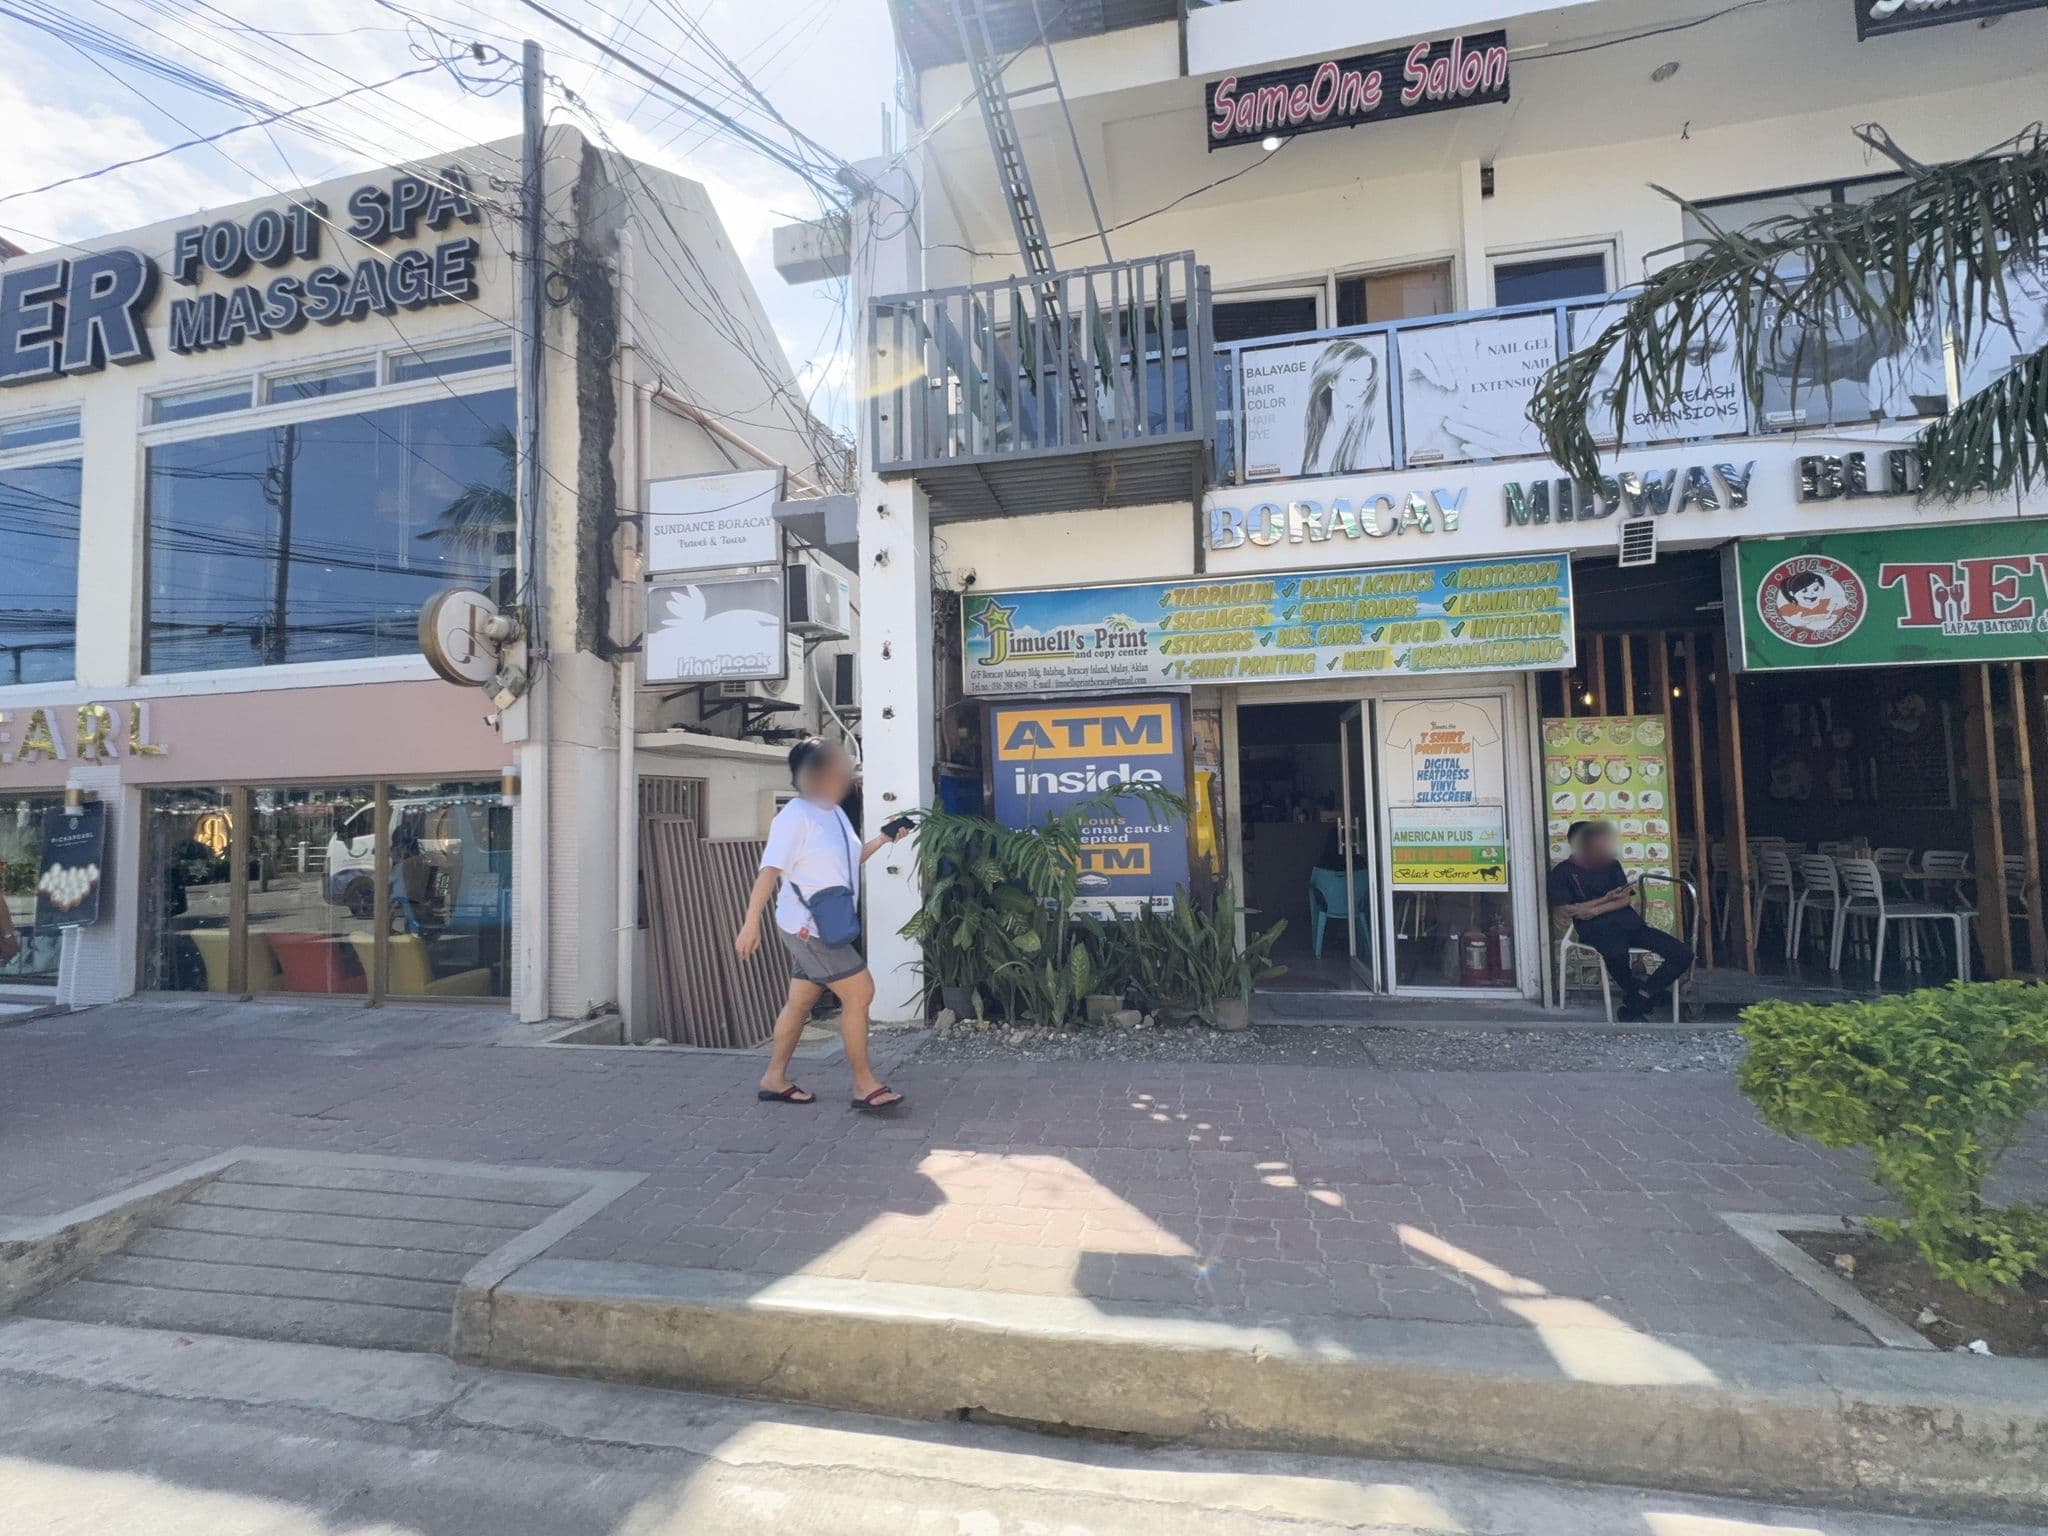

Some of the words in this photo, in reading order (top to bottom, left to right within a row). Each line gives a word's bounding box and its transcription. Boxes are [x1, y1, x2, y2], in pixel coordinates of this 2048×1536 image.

[1212, 62, 1382, 139] SameOne
[1401, 37, 1508, 106] Salon
[172, 199, 328, 285] FOOT
[346, 164, 480, 246] SPA
[168, 237, 478, 354] MASSAGE
[0, 246, 158, 388] ER
[1487, 343, 1520, 355] NAIL
[1524, 339, 1552, 351] GEL
[1246, 361, 1306, 378] BALAYAGE
[1247, 384, 1275, 396] HAIR
[1247, 397, 1286, 411] COLOR
[1633, 402, 1738, 425] EXTENSIONS
[1247, 414, 1275, 426] HAIR
[1209, 487, 1468, 550] BORACAY
[1503, 460, 1758, 528] MIDWAY
[1796, 447, 1930, 503] BLD
[653, 520, 716, 536] SUNDANCE
[717, 516, 773, 531] BORACAY
[678, 539, 707, 549] Travel
[709, 538, 718, 546] &
[719, 535, 747, 545] Tours
[1301, 576, 1360, 598] PLASTIC
[1361, 571, 1434, 594] ACRYLICS
[1457, 563, 1561, 589] PHOTOCOPY
[1174, 582, 1275, 606] TARPAULIN
[1459, 588, 1559, 614] LAMINATION
[1878, 553, 2048, 628] TE
[1171, 606, 1267, 631] SIGNAGES
[1301, 601, 1355, 623] SINTRA
[1356, 598, 1418, 621] BOARDS
[1316, 624, 1362, 646] CARDS
[1389, 622, 1421, 645] PVC
[1421, 620, 1441, 642] ID
[1469, 613, 1562, 640] INVITATION
[1944, 621, 1978, 634] LAPAZ
[1983, 619, 2032, 633] BATCHOY
[978, 628, 1085, 666] Jimuell's
[1094, 627, 1148, 649] Print
[1075, 649, 1092, 659] and
[1094, 648, 1115, 662] copy
[1117, 647, 1148, 657] center
[1171, 632, 1253, 655] STICKERS
[1525, 639, 1565, 662] MUG
[1174, 656, 1237, 680] T-SHIRT
[1238, 653, 1316, 677] PRINTING
[1341, 650, 1385, 672] MENU
[0, 701, 169, 763] ARL
[1003, 714, 1163, 750] ATM
[1420, 732, 1429, 744] T
[1429, 730, 1466, 743] SHIRT
[1416, 769, 1470, 781] HEATPRESS
[1424, 757, 1461, 770] DIGITAL
[1014, 763, 1163, 795] inside
[1430, 780, 1457, 791] VINYL
[1416, 791, 1473, 803] SILKSCREEN
[1070, 834, 1129, 845] epted
[1393, 831, 1445, 842] AMERICAN
[1447, 830, 1473, 841] PLUS
[1066, 848, 1145, 870] TM
[1394, 868, 1430, 879] Black
[1433, 867, 1471, 879] Horse
